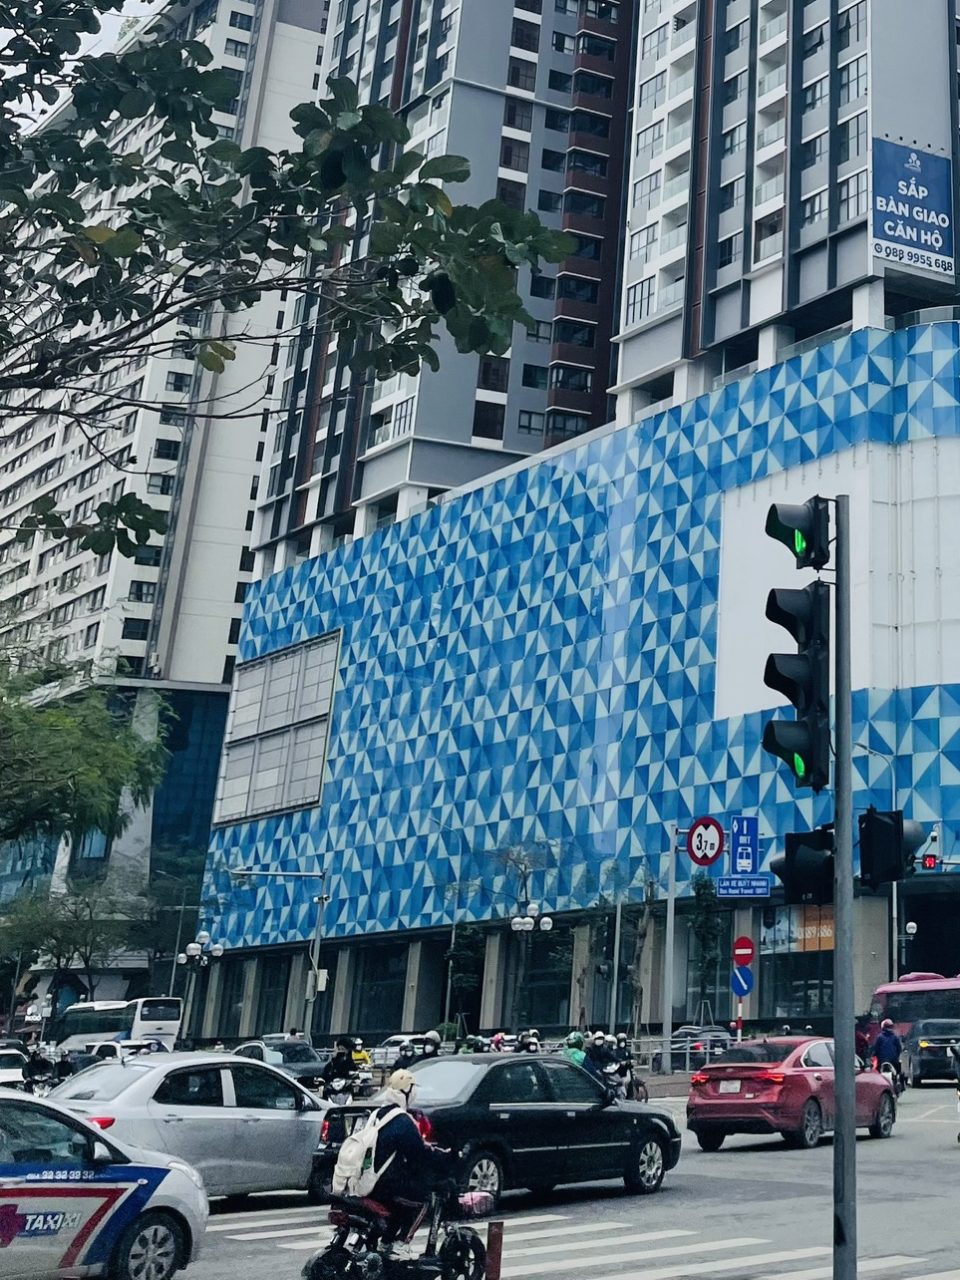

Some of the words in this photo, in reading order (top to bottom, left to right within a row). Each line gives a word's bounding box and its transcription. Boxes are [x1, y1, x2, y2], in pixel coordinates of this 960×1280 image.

[897, 176, 929, 200] SẮP
[876, 195, 910, 218] BÀN
[912, 208, 950, 228] GIAO
[883, 219, 918, 242] CĂN
[920, 229, 943, 251] HỘ
[25, 1214, 64, 1231] TAXI
